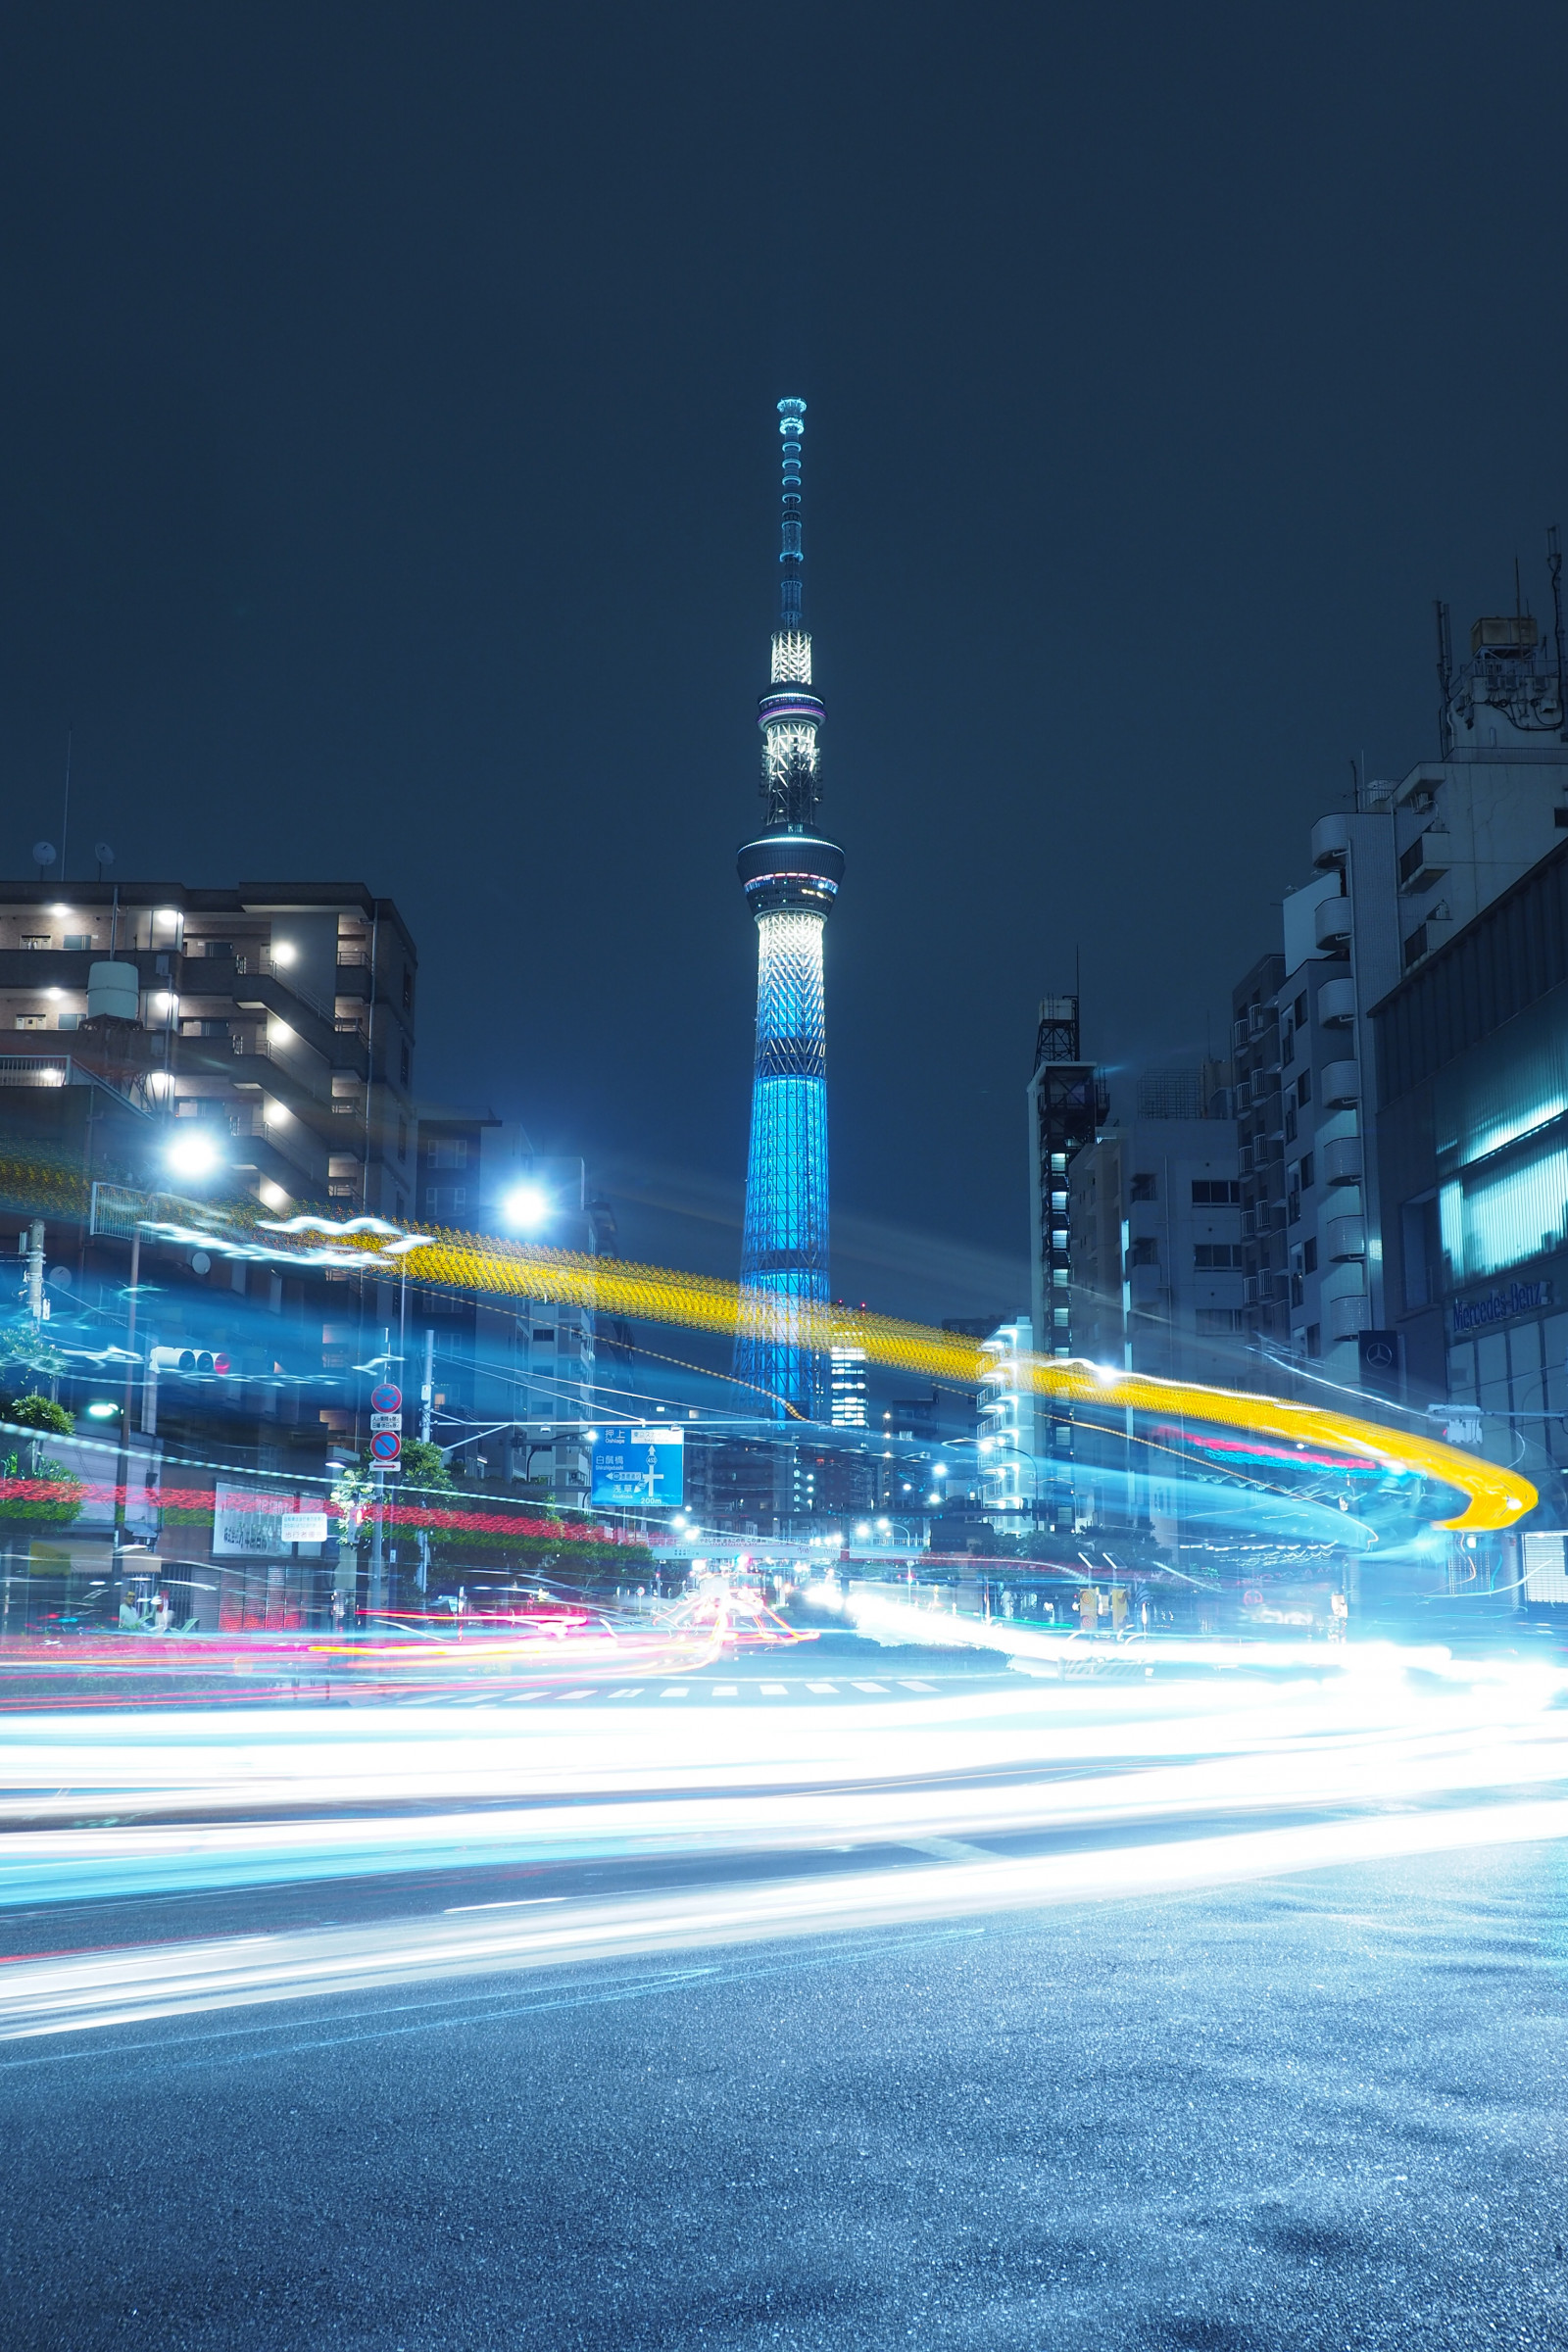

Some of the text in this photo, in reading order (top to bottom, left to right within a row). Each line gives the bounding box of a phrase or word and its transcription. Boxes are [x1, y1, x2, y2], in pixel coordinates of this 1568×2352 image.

[1453, 1281, 1545, 1332] Mercedes-Benz
[605, 1429, 625, 1439] 押上
[612, 1484, 632, 1494] 浅草
